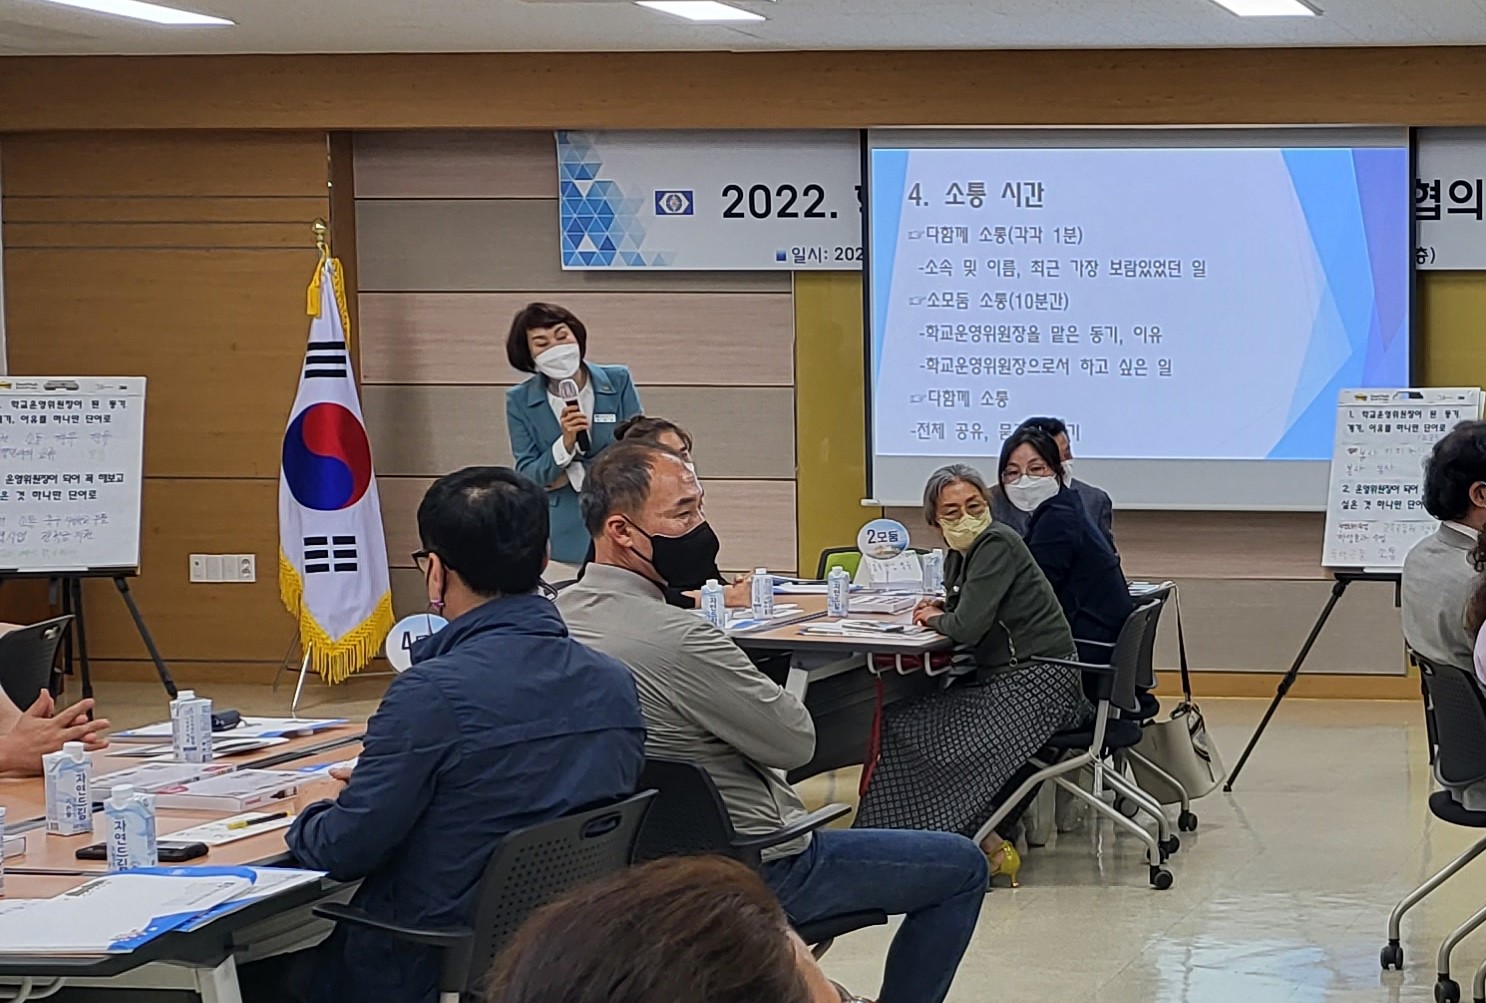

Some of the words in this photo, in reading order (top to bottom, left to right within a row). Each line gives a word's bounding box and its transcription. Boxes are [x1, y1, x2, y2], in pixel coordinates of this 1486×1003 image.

[721, 184, 838, 219] 2022.
[908, 183, 929, 206] 4.
[945, 182, 986, 208] 소통
[1001, 182, 1044, 208] 시간
[926, 226, 968, 244] 다함께
[979, 226, 1043, 244] 소통(각각
[1053, 226, 1083, 245] 1분)
[792, 247, 828, 263] 일시:
[834, 247, 864, 261] 202
[987, 260, 1020, 279] 이름,
[1031, 260, 1060, 277] 최근
[1070, 260, 1098, 278] 가장
[1109, 260, 1182, 278] 보람있었던
[1192, 260, 1206, 278] 일
[927, 293, 969, 309] 소모둠
[980, 293, 1069, 311] 소통(10분간)
[919, 324, 1041, 343] -학교운영위원장을
[1090, 326, 1123, 345] 동기,
[1134, 326, 1163, 343] 이유
[920, 357, 1070, 376] -학교운영위원장으로서
[1080, 358, 1108, 375] 하고
[1119, 358, 1148, 377] 싶은
[1158, 359, 1173, 376] 일
[928, 390, 970, 407] 다함께
[980, 390, 1009, 408] 소통
[955, 422, 988, 442] 공유,
[1407, 500, 1424, 510] 단어
[867, 529, 899, 545] 2모둠
[76, 772, 87, 821] 자연드림
